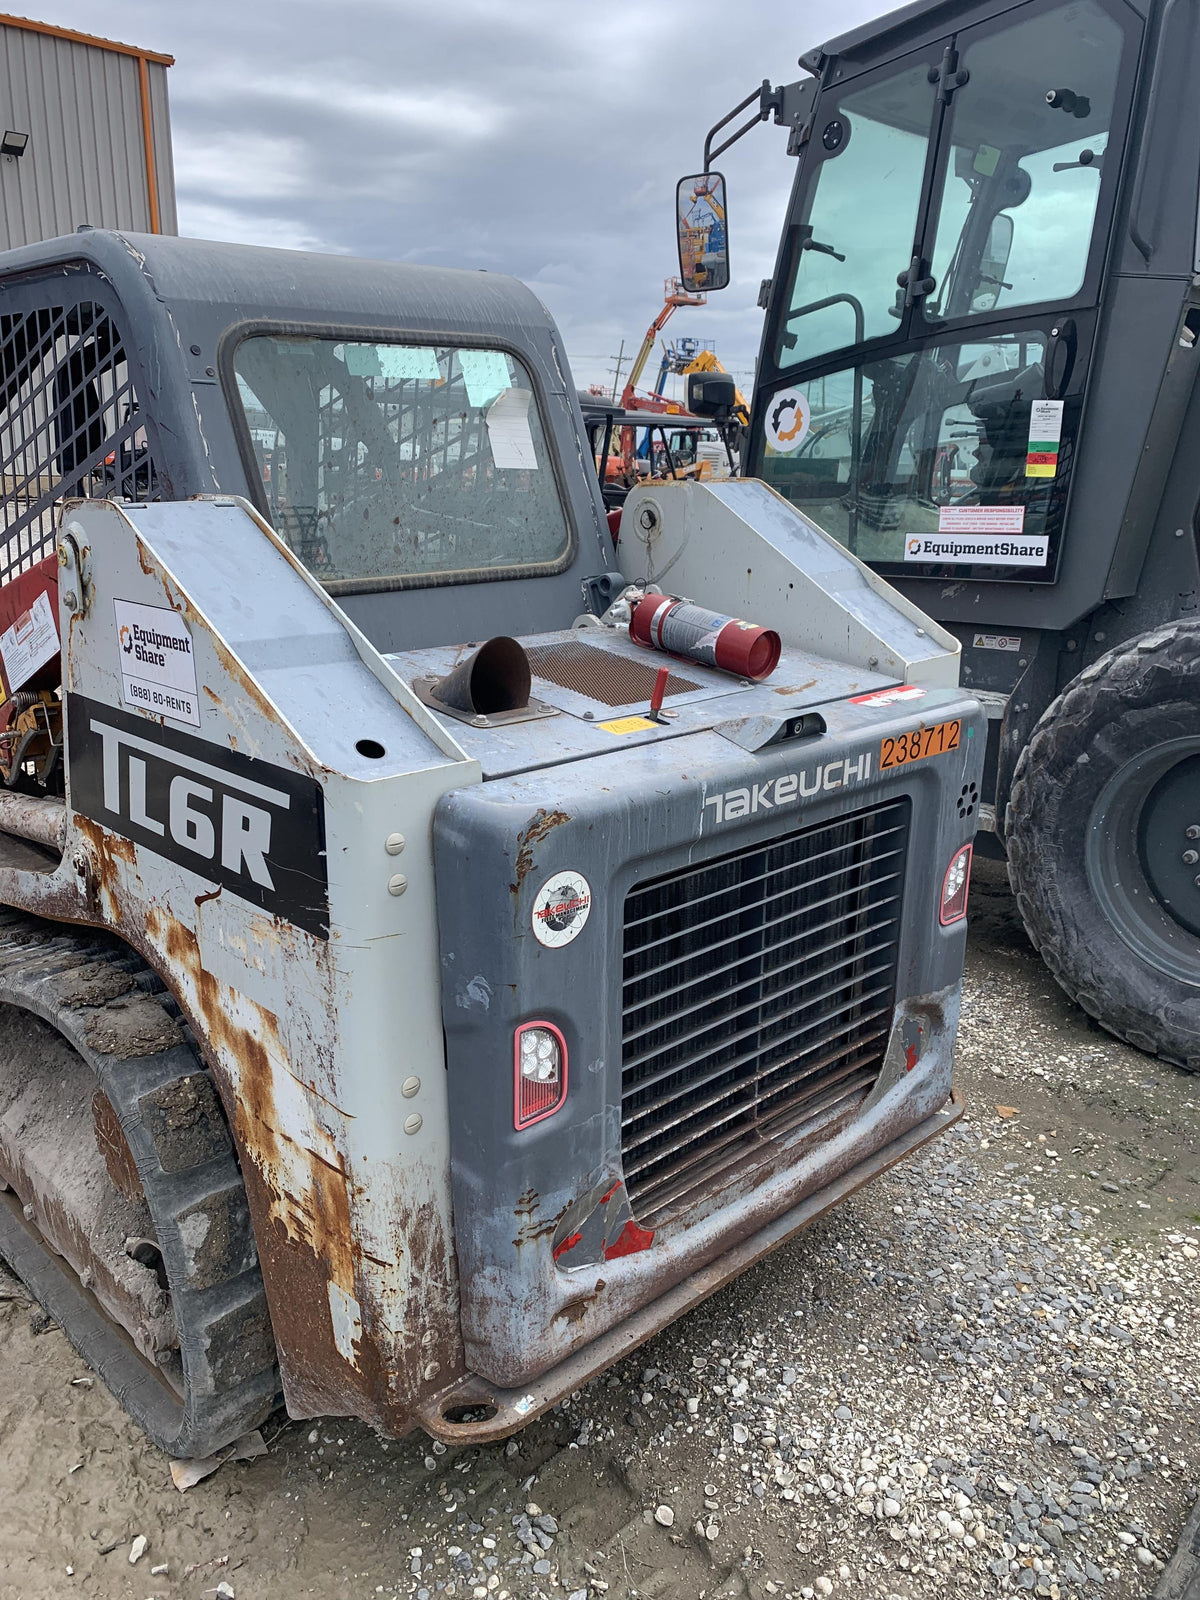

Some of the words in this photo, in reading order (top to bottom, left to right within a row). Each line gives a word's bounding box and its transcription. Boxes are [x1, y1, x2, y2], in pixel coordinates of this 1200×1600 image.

[923, 541, 1044, 557] EquipmentShare
[132, 624, 191, 653] Equipment
[134, 644, 165, 667] Share
[130, 684, 151, 702] (888)
[153, 692, 192, 714] 80-RENTS
[881, 720, 960, 769] 238712
[90, 718, 291, 892] TL6R
